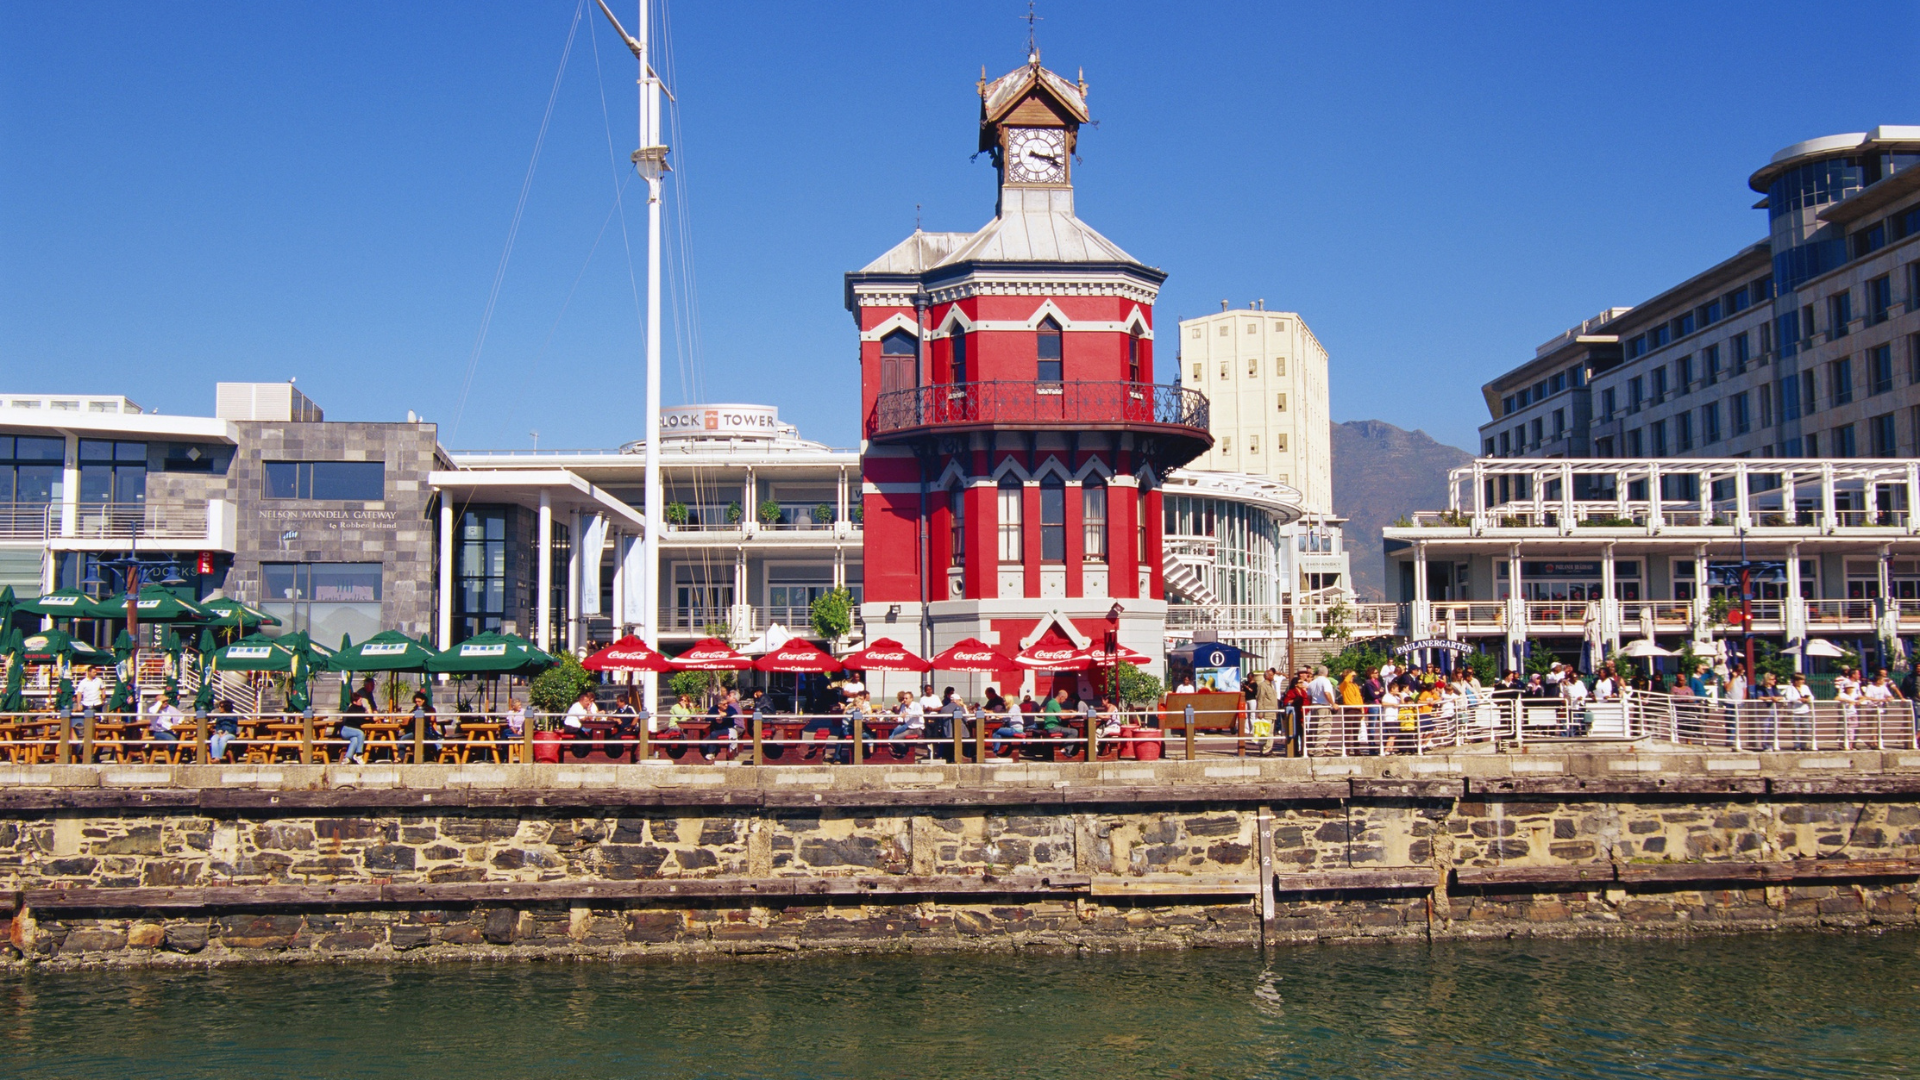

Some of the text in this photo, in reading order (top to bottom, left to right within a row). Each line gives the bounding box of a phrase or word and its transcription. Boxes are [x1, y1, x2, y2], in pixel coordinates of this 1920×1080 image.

[659, 414, 775, 428] LOCK TOWER
[259, 510, 397, 520] NELSON MANDELA GATEWAY
[152, 567, 198, 577] DOKS
[1396, 639, 1474, 655] PAULANERGARTEN
[1263, 856, 1271, 866] 2
